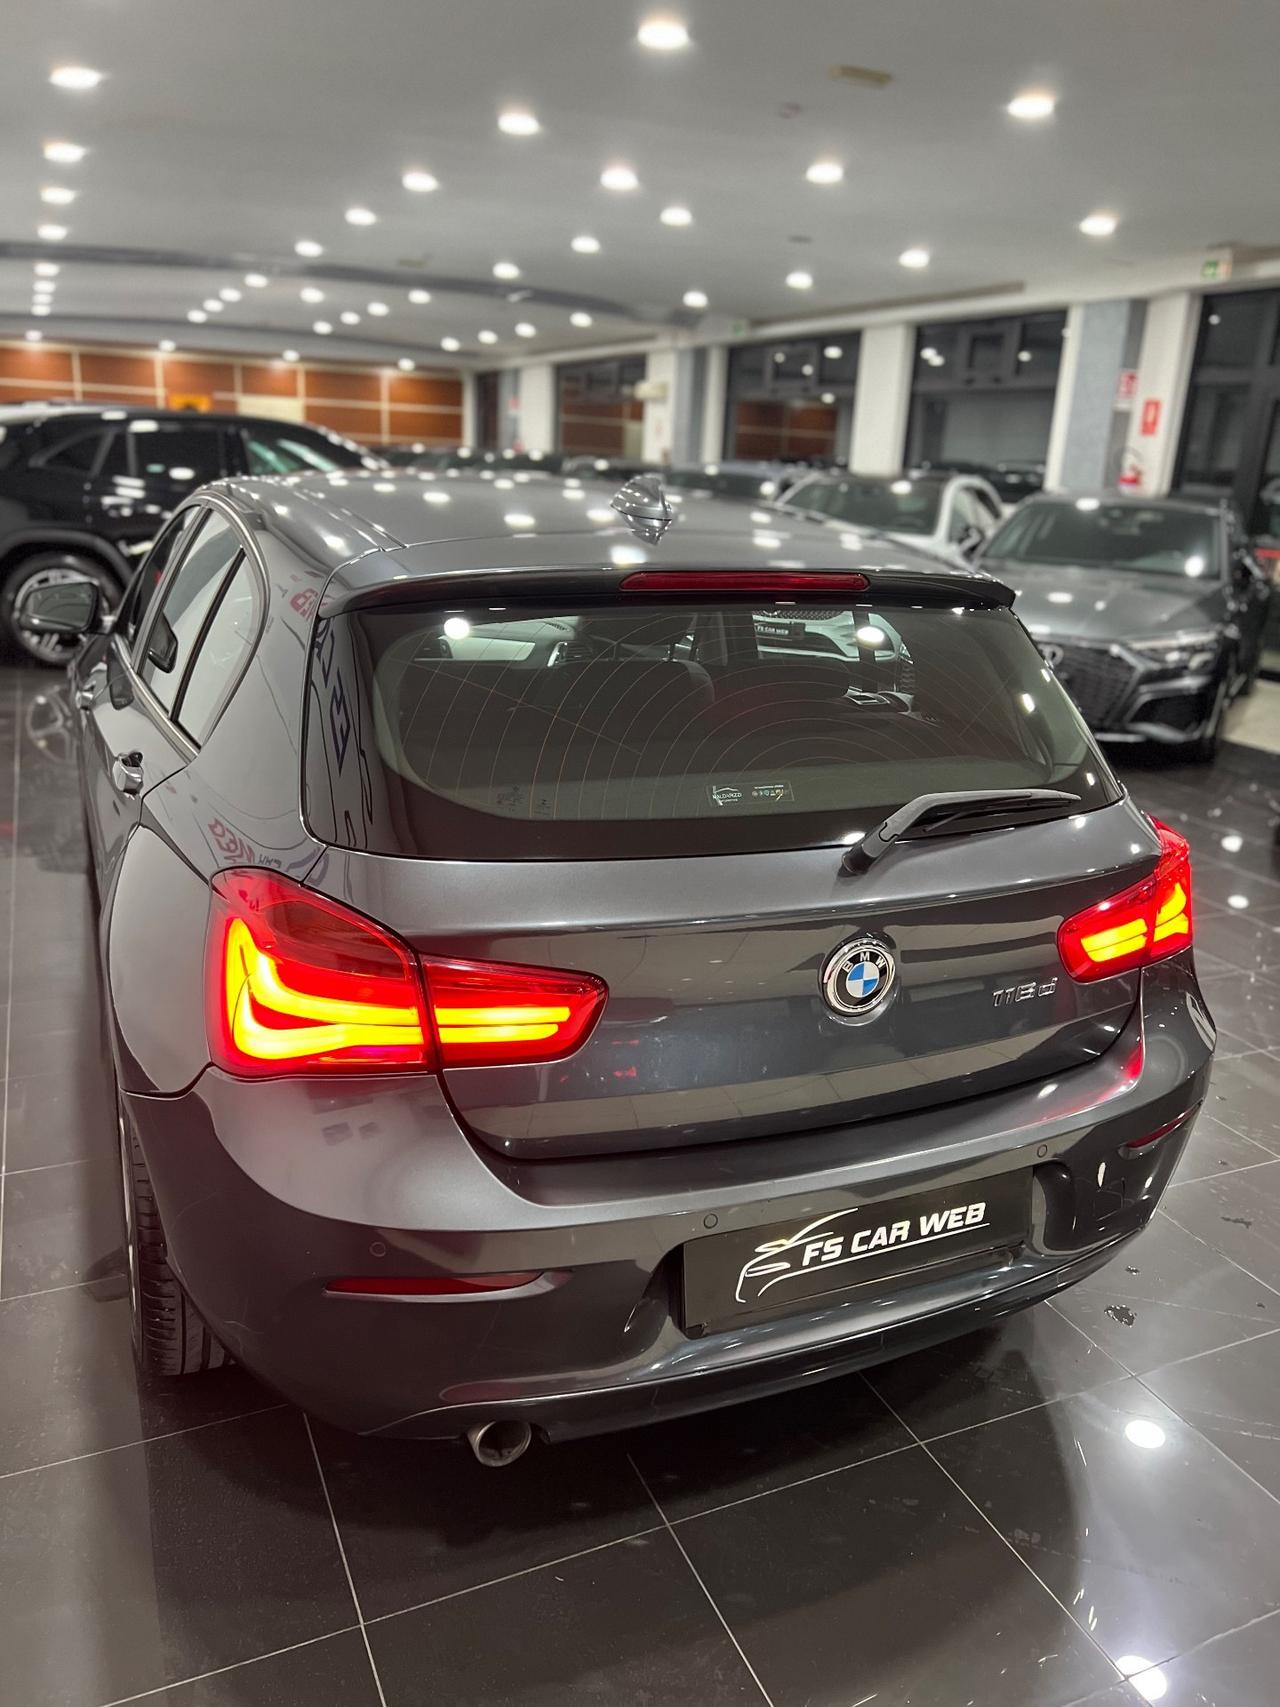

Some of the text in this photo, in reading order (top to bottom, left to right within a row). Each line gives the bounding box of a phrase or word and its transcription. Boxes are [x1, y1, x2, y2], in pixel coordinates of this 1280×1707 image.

[842, 951, 886, 973] BMW
[802, 1202, 986, 1266] FS CAR WEB
